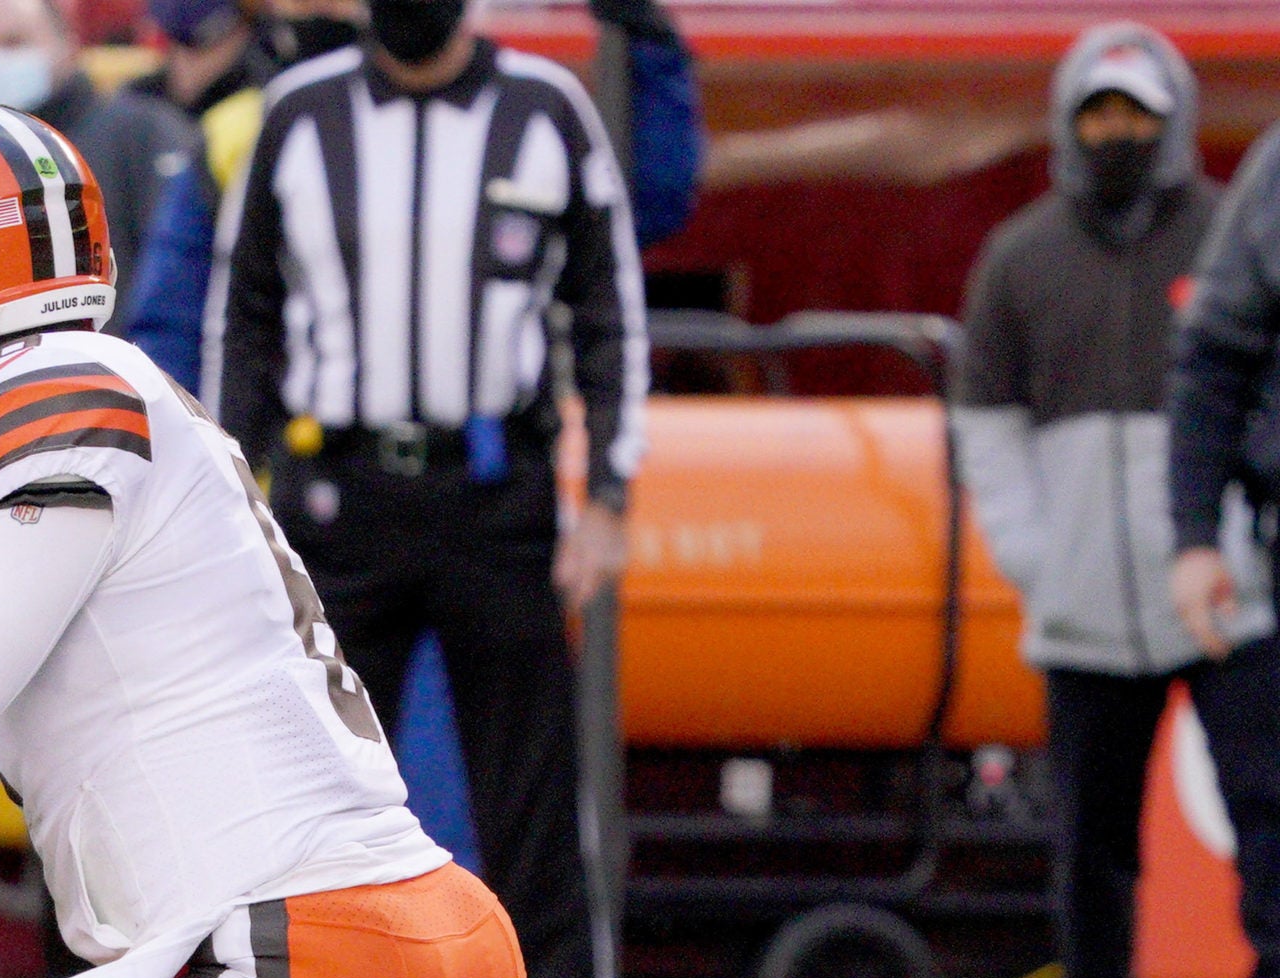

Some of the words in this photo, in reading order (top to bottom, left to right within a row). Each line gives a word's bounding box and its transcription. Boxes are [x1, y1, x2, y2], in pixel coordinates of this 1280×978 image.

[40, 297, 78, 314] JULIUS
[81, 295, 106, 310] JONES
[14, 505, 37, 521] NFL
